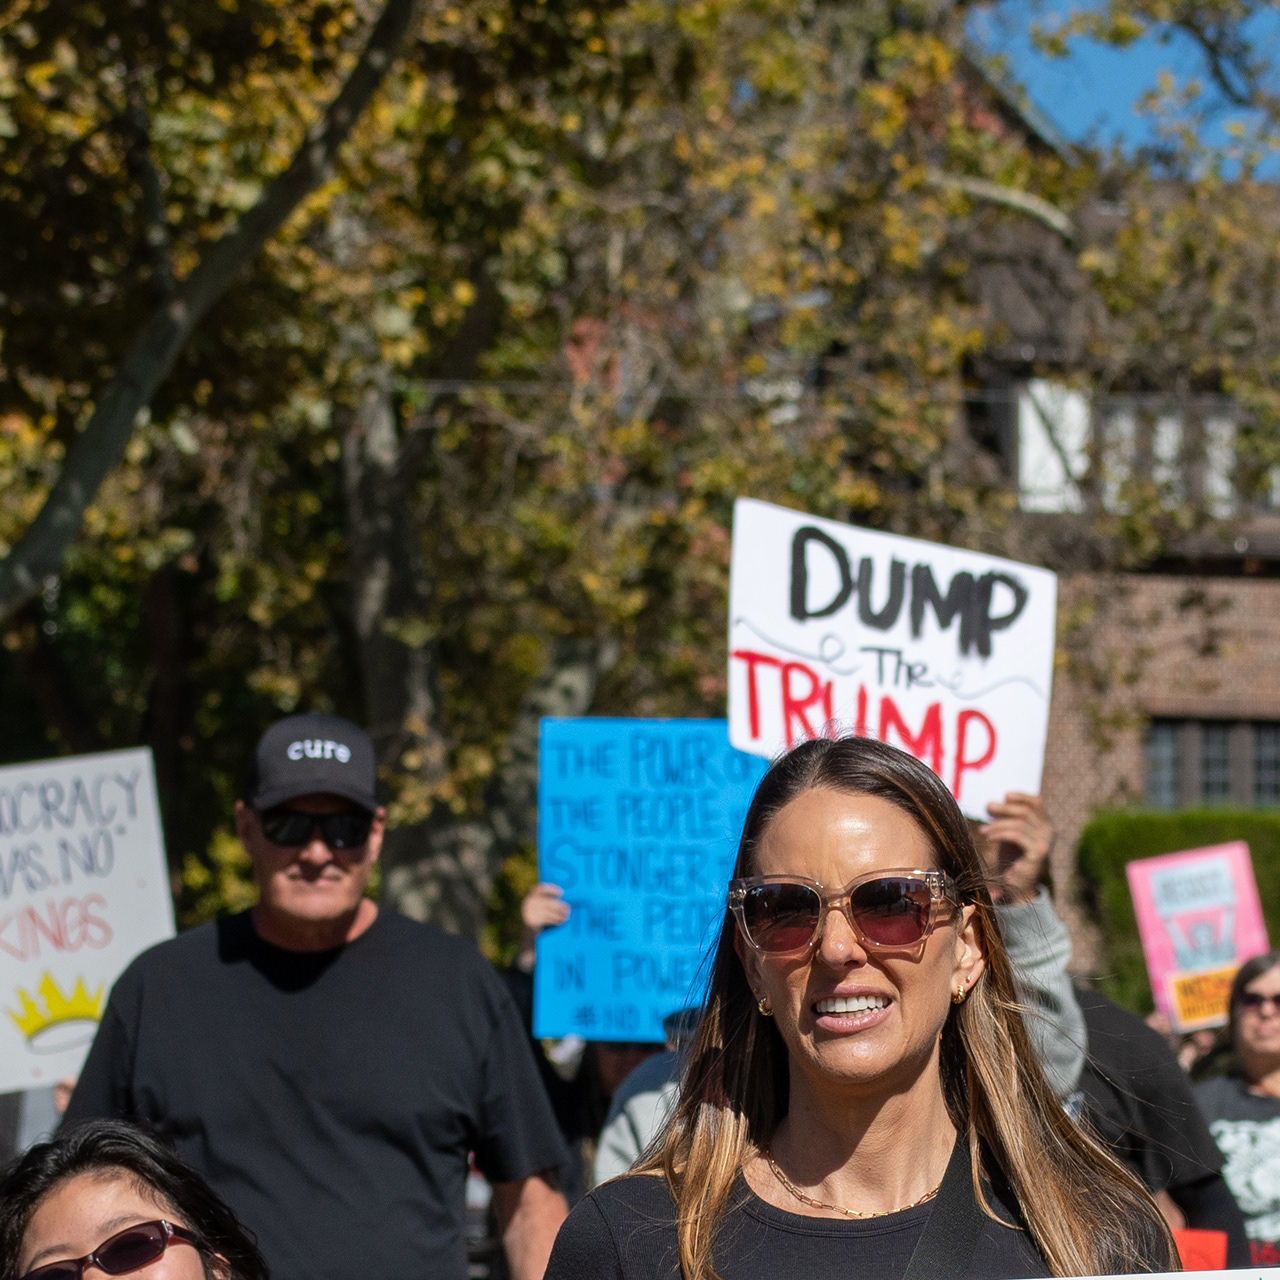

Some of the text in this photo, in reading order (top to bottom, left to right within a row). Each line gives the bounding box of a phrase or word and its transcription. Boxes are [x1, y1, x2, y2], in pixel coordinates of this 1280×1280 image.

[789, 525, 1029, 658] DUMP
[859, 645, 937, 690] The
[730, 650, 997, 800] TRUMP
[287, 737, 352, 764] cure
[551, 740, 616, 779] THE
[548, 796, 603, 832] THE
[615, 790, 721, 839] PEOPLE
[61, 828, 116, 888] NO
[566, 898, 625, 941] THE
[552, 948, 700, 996] IN POWE
